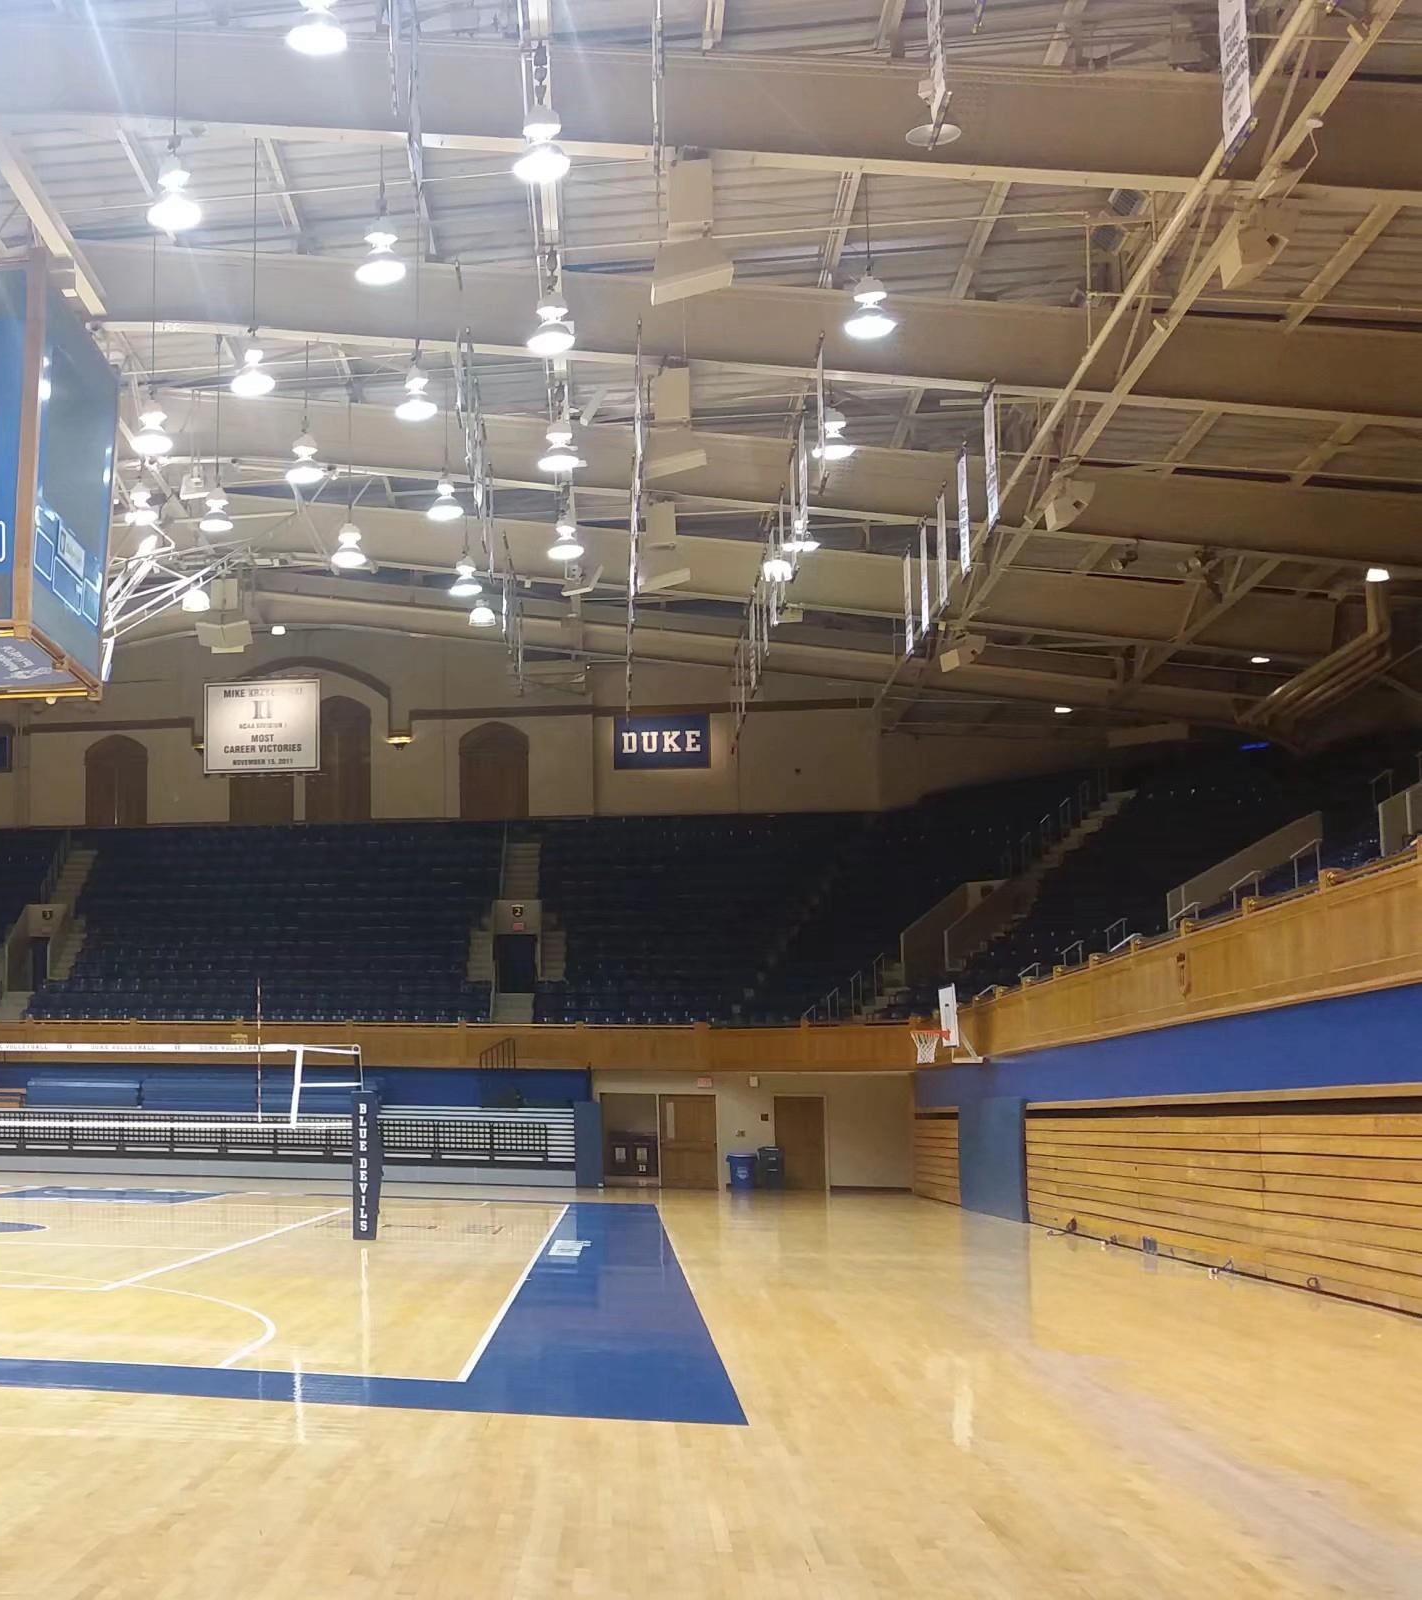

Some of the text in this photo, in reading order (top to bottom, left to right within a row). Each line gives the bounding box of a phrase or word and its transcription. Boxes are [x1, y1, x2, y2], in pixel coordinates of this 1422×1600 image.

[223, 688, 245, 699] MIKE
[251, 734, 274, 742] MOST
[621, 730, 701, 754] DUKE
[223, 743, 302, 754] CAREER VICTORIES
[358, 1103, 368, 1232] BLUE DEVILS
